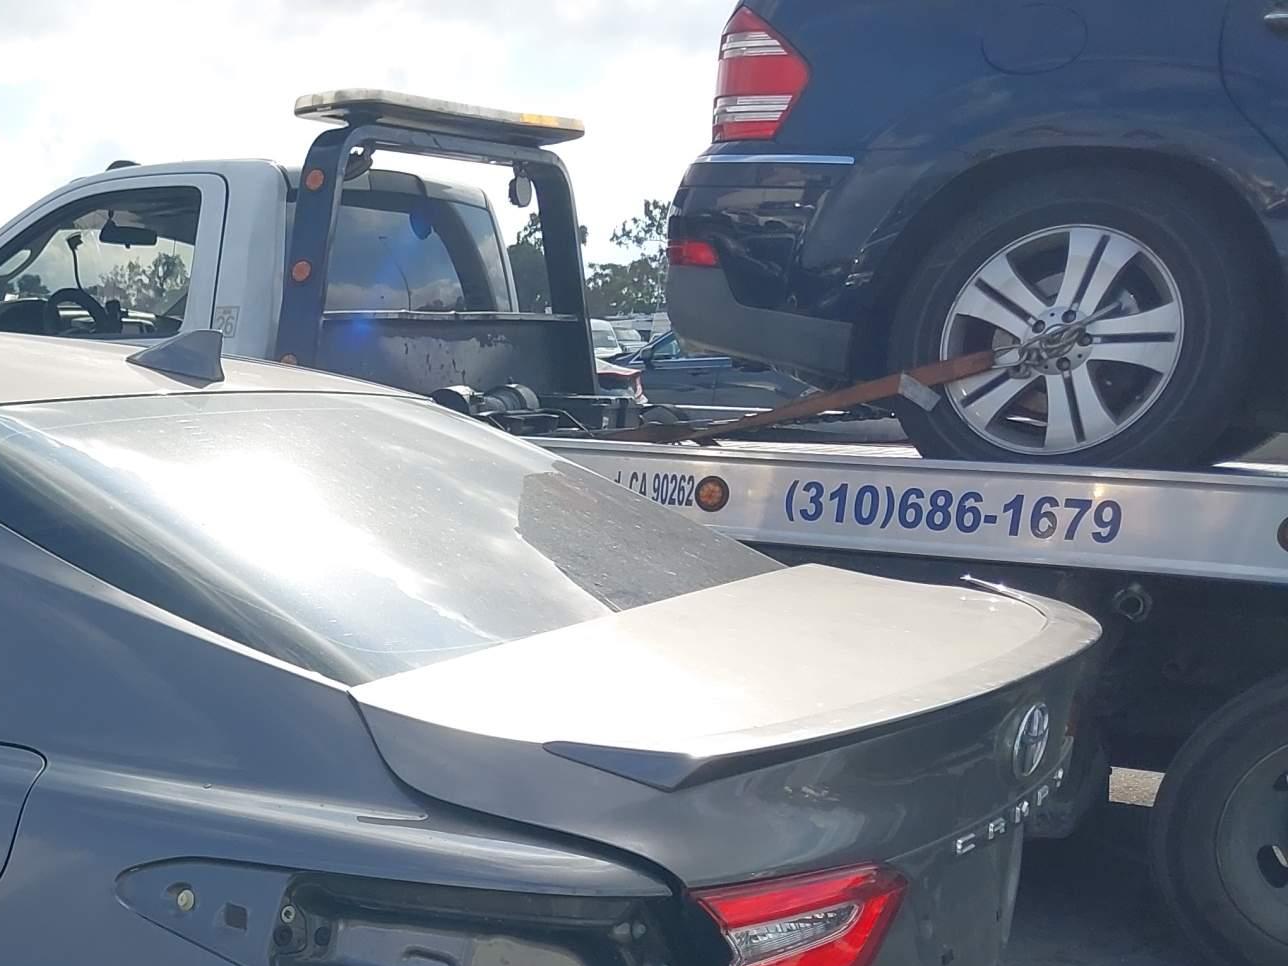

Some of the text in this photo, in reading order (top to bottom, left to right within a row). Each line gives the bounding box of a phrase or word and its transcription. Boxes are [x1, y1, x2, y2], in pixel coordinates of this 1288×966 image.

[628, 471, 647, 497] CA
[651, 472, 695, 507] 90262
[785, 480, 1122, 544] (310)686-1679
